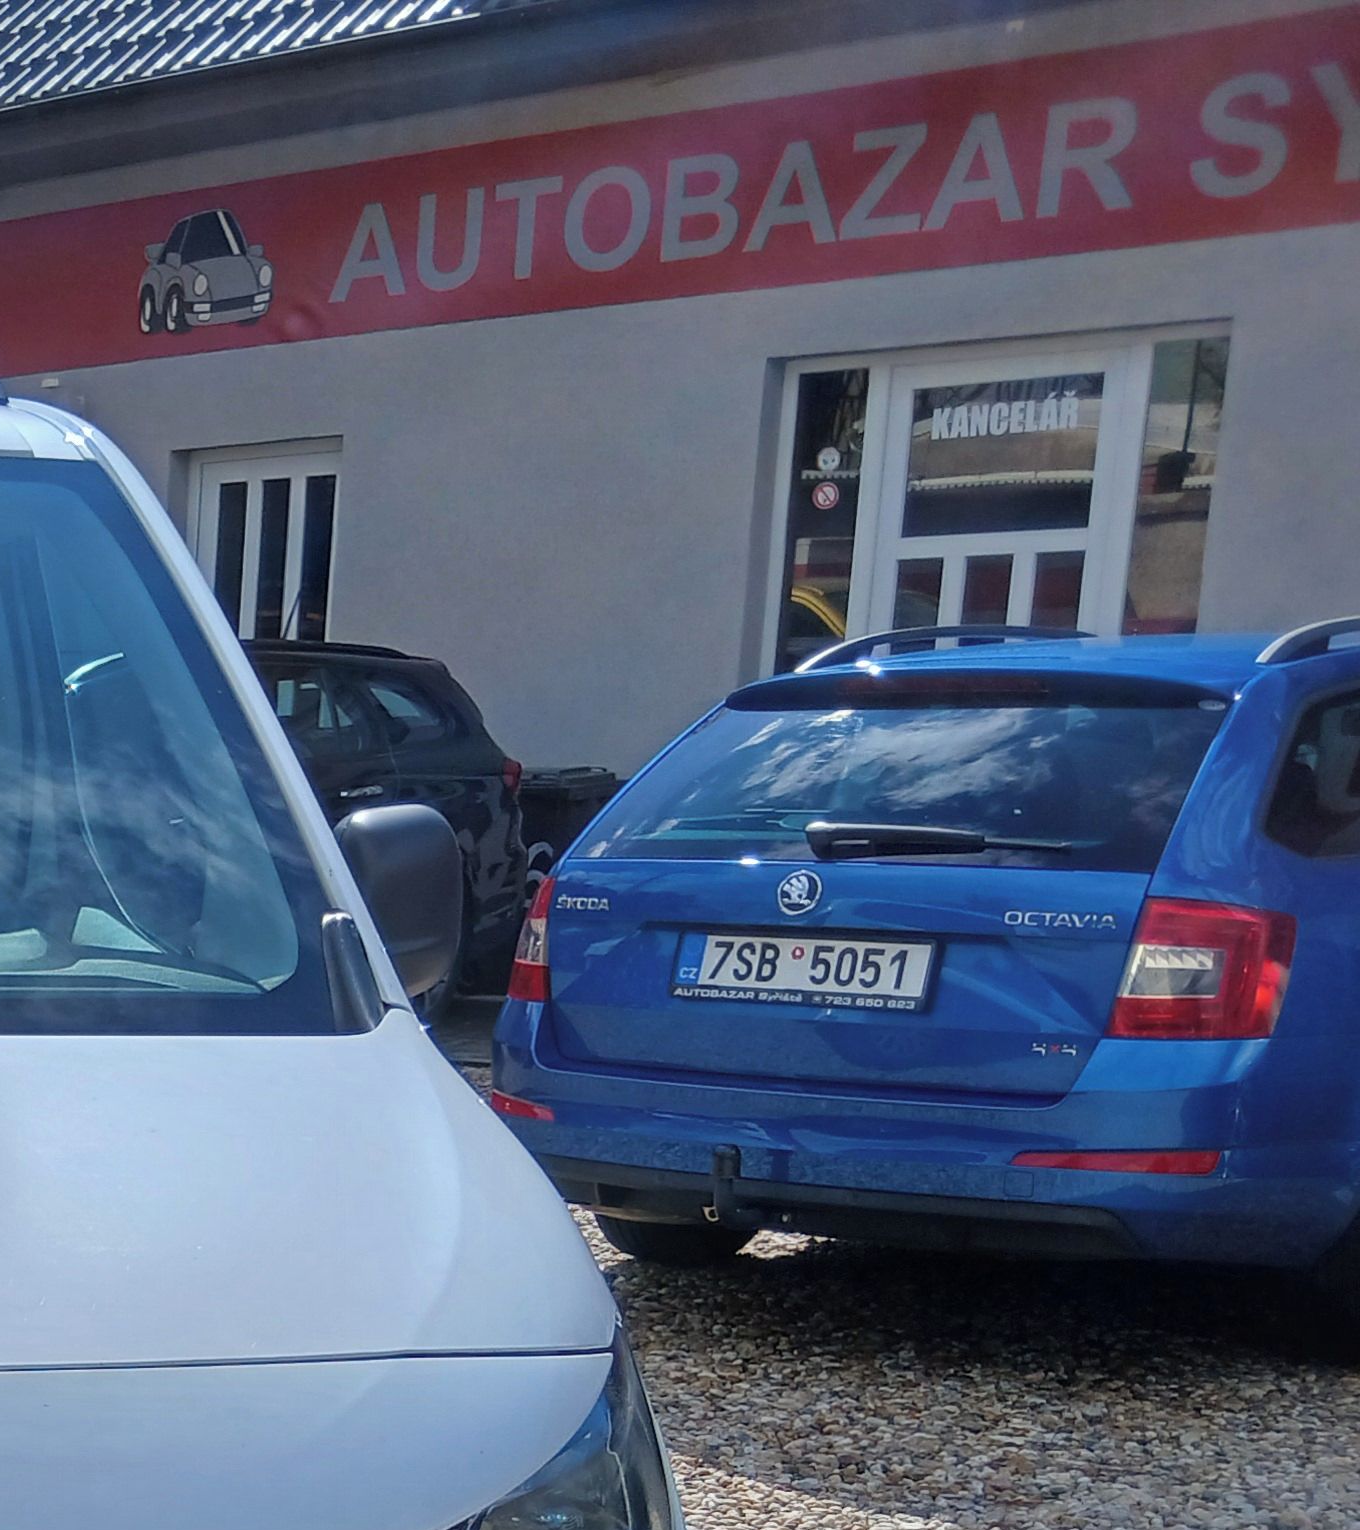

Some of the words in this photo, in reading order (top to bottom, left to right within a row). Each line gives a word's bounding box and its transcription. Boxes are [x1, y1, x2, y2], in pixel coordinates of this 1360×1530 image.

[328, 97, 1139, 304] AUTOBAZAR
[930, 390, 1080, 440] KANCELÁŘ
[555, 893, 610, 911] ŠKODA
[1003, 910, 1117, 929] OCTAVIA
[679, 966, 698, 980] CZ
[708, 941, 781, 983] 7SB
[808, 945, 909, 991] 5051
[672, 987, 755, 1001] AUTOBAZAR
[823, 995, 852, 1006] 723
